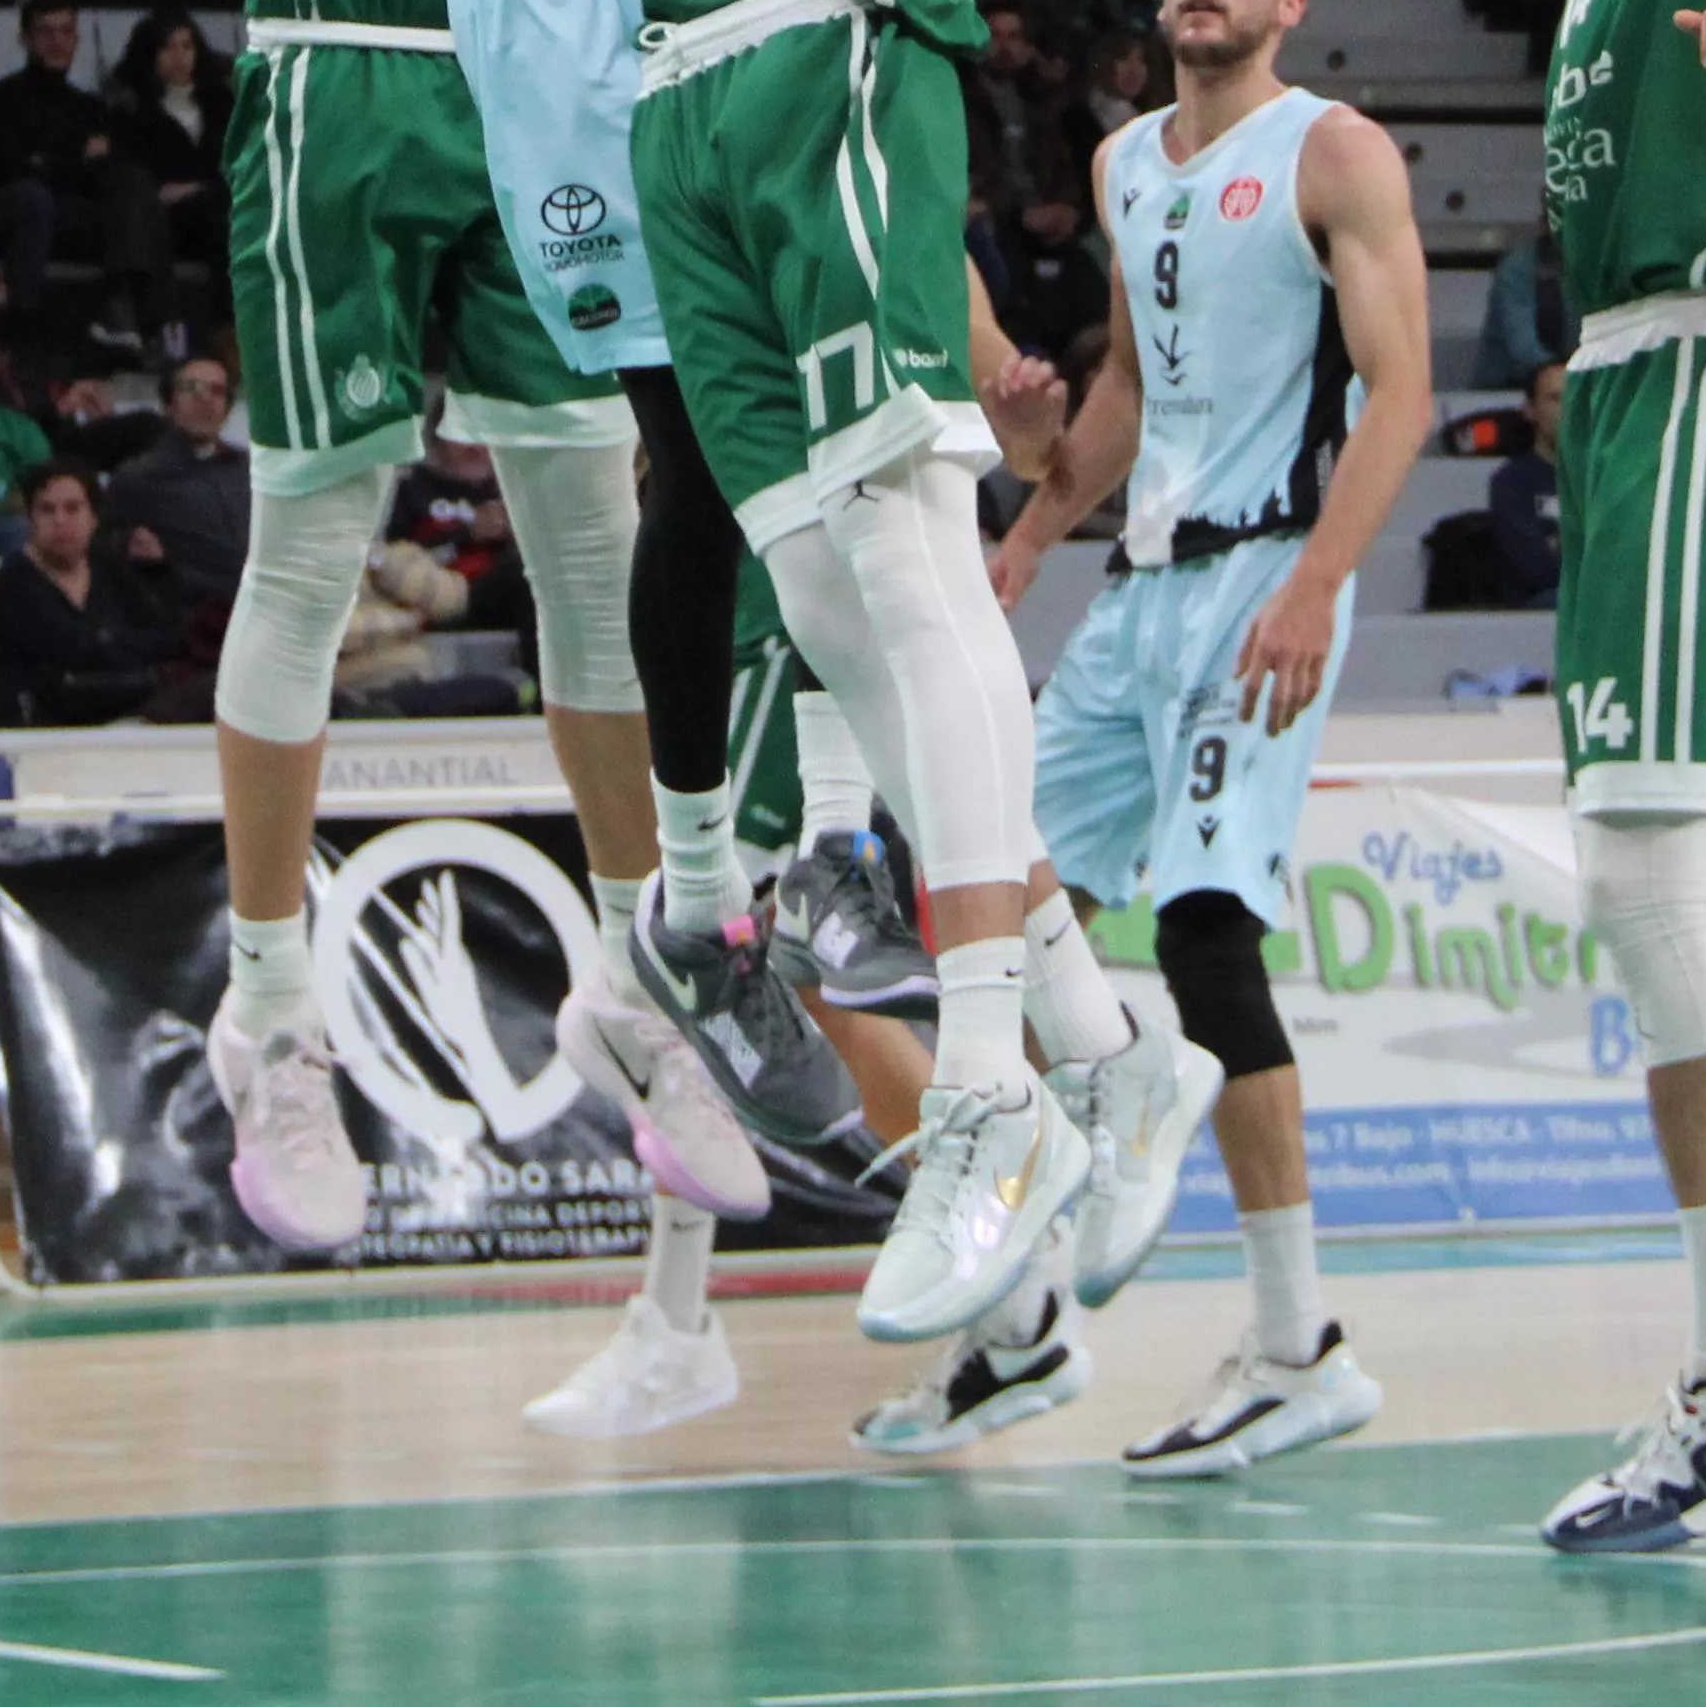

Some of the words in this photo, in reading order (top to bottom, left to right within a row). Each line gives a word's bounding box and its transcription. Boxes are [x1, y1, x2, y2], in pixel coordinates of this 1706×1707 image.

[539, 234, 623, 258] TOYOTA
[1154, 241, 1179, 309] 9
[1566, 677, 1634, 755] 14
[324, 754, 520, 791] ANANTIAL
[1189, 735, 1227, 802] 9
[1362, 830, 1504, 907] Viajes
